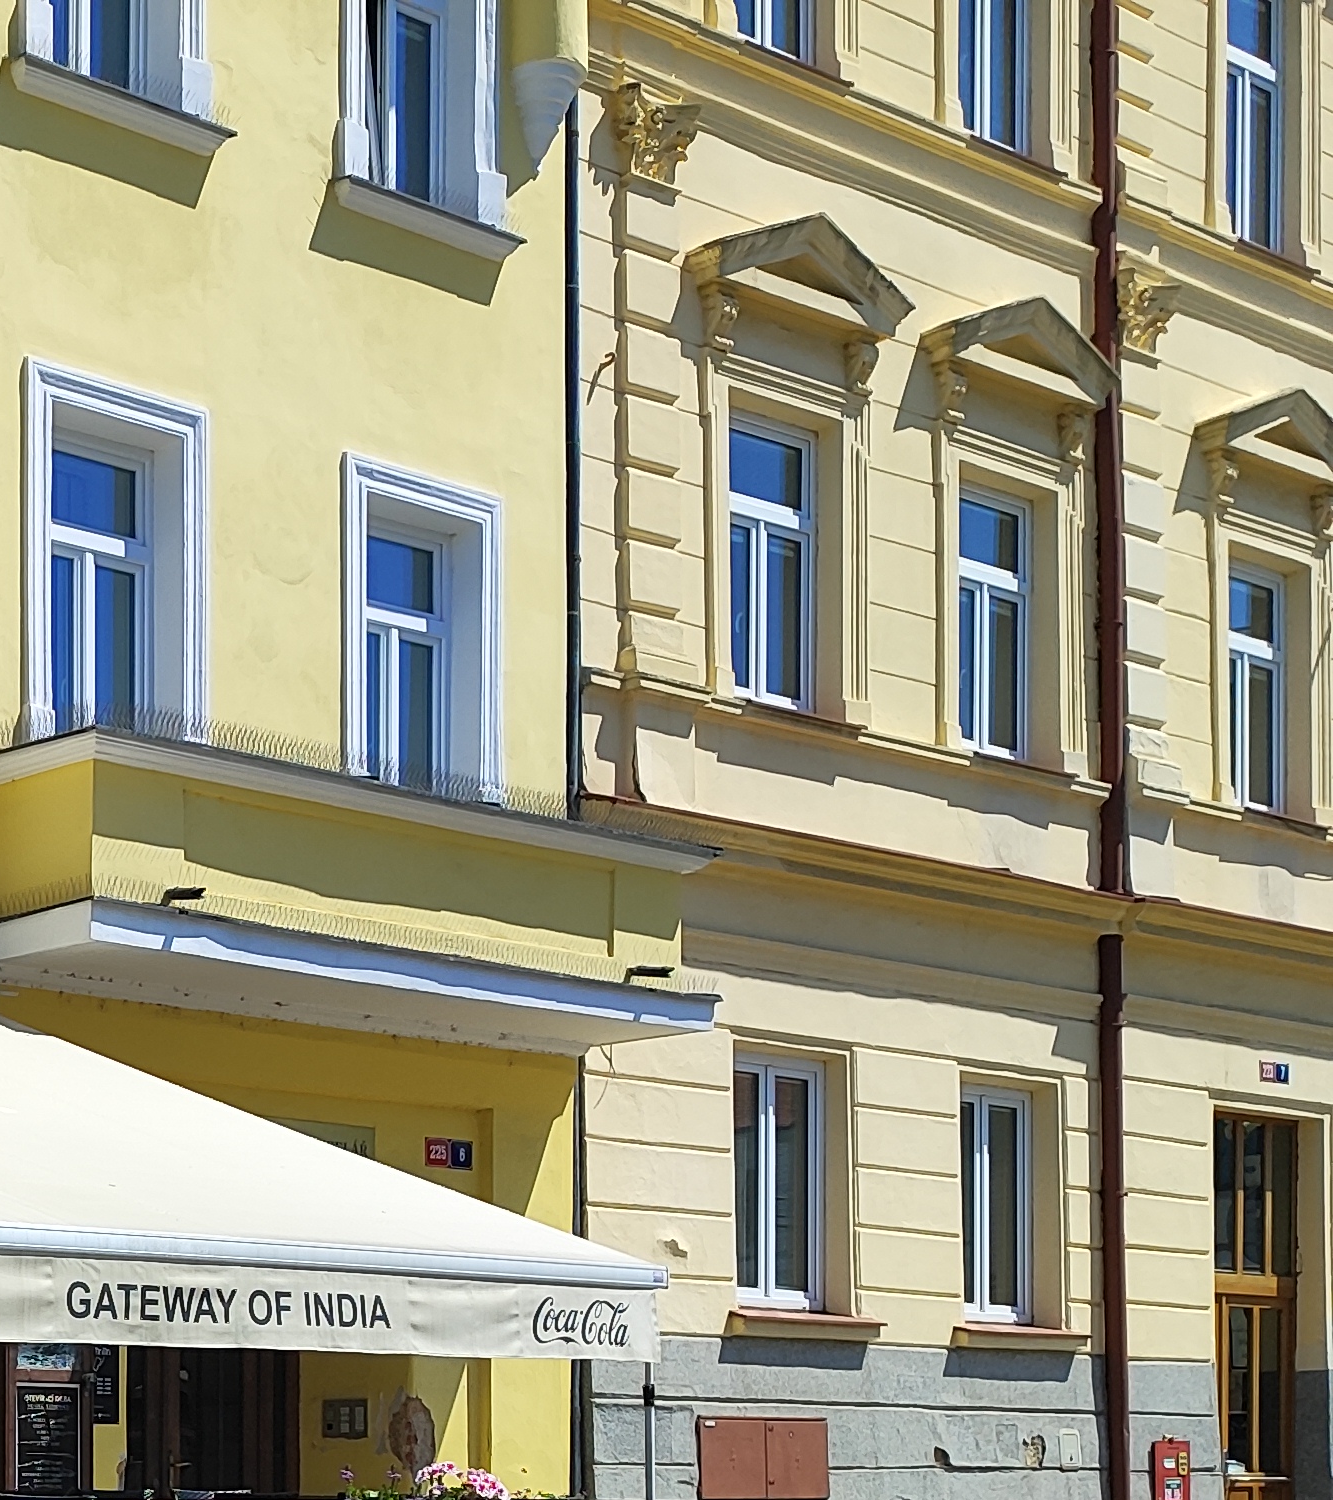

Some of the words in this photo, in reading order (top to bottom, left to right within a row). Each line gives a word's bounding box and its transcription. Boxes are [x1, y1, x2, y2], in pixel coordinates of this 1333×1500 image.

[429, 1144, 447, 1160] 225
[459, 1147, 466, 1162] 6
[66, 1280, 238, 1324] GATEWAY
[248, 1289, 293, 1326] OF
[303, 1291, 392, 1329] INDIA
[532, 1296, 631, 1348] Coca-Cola
